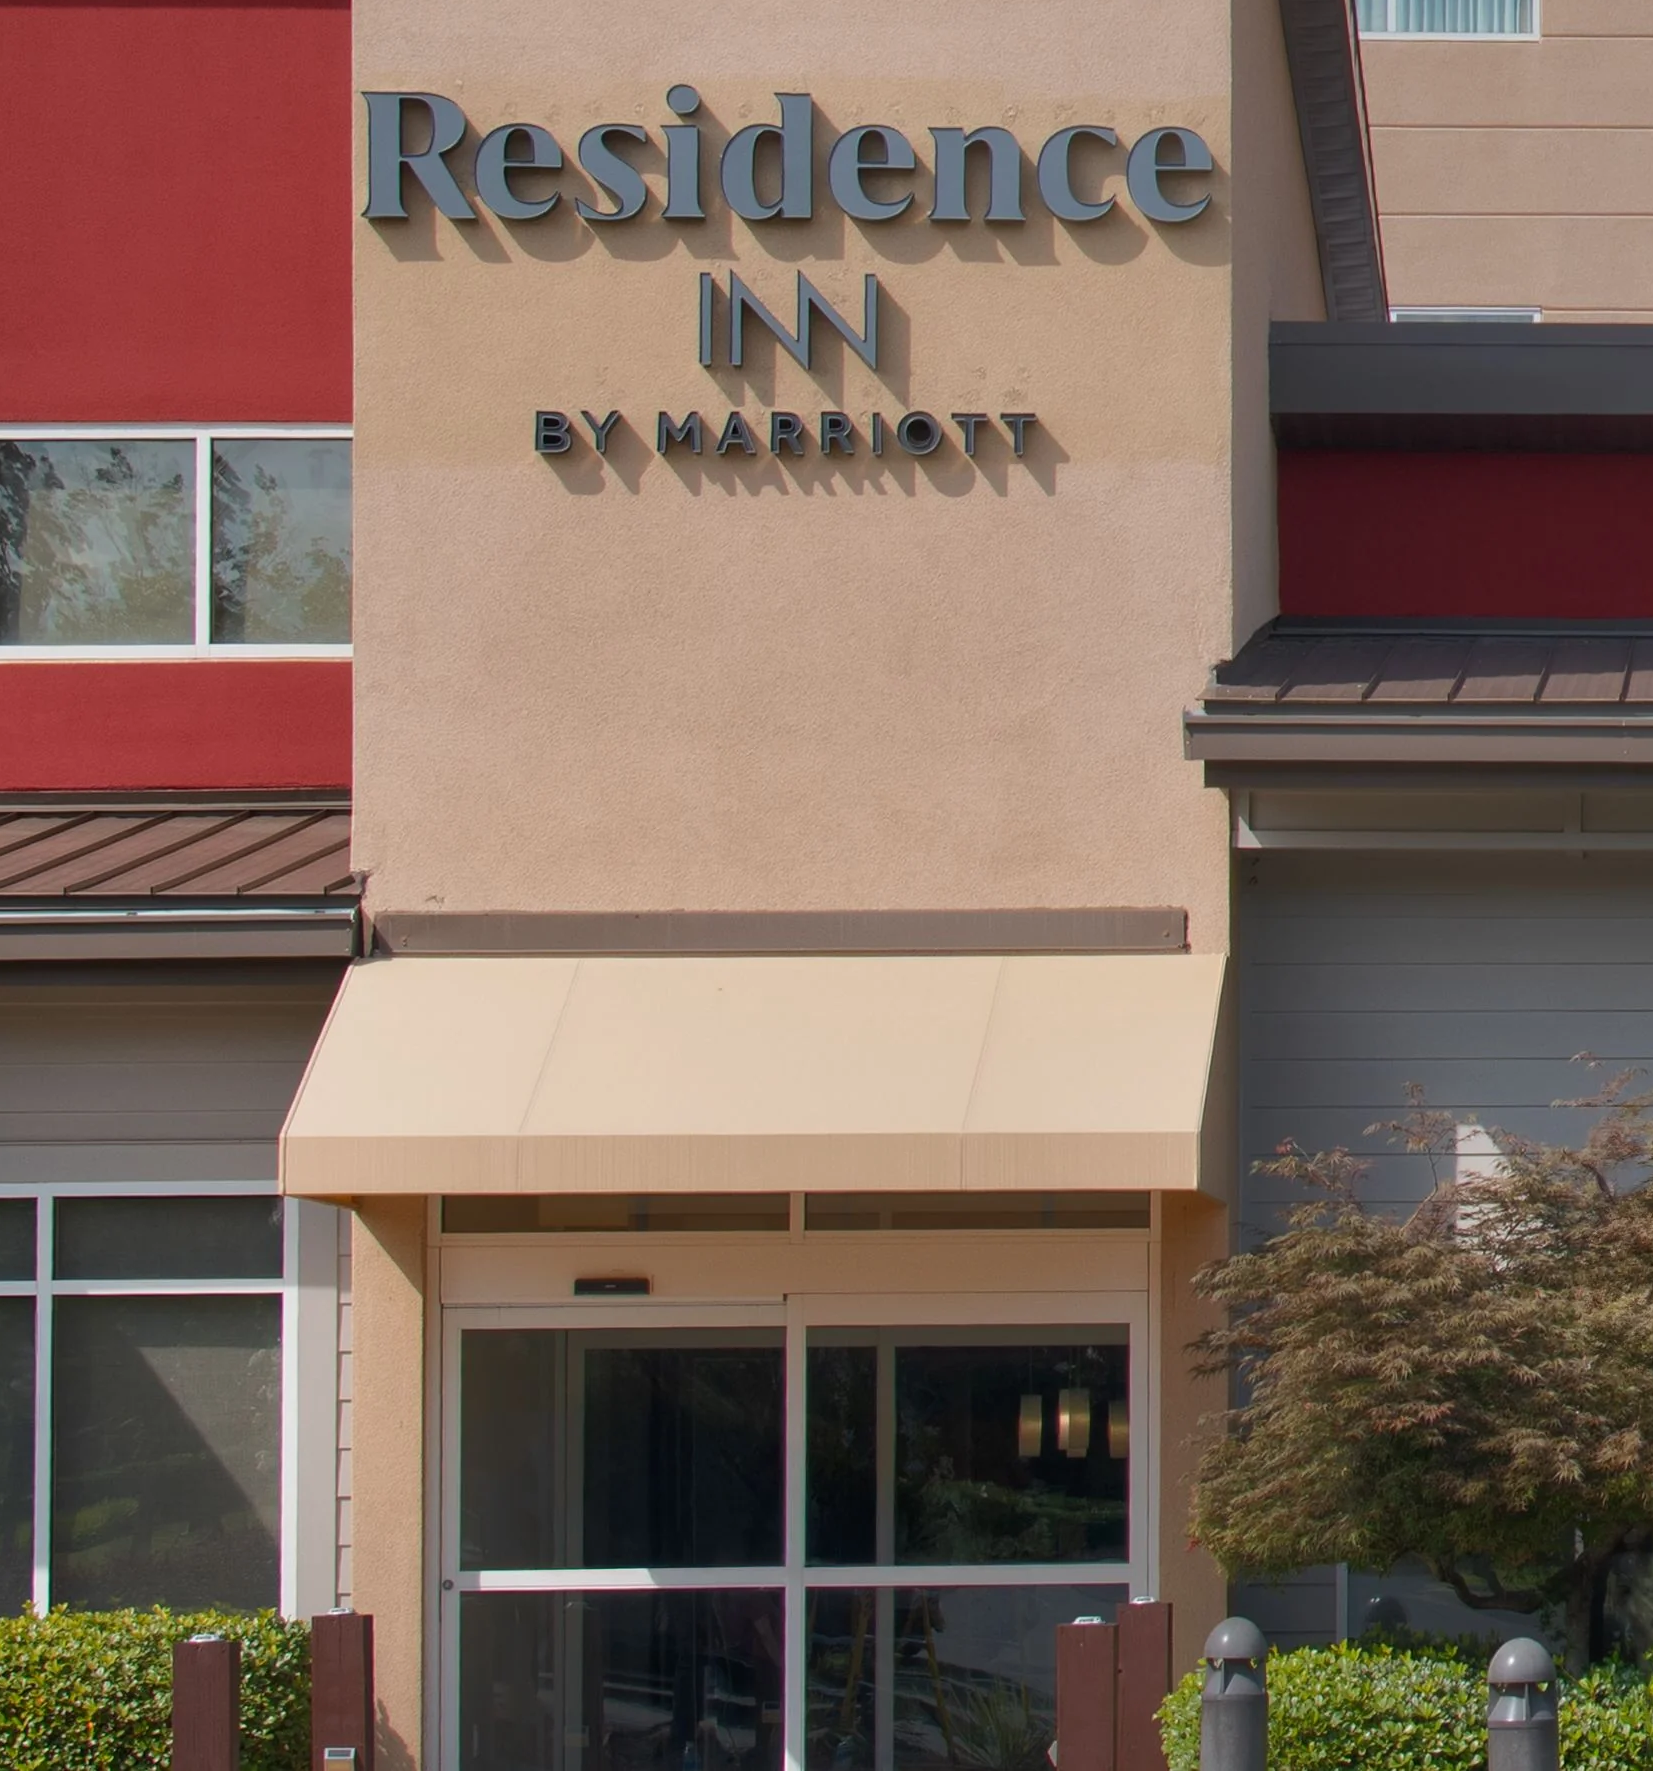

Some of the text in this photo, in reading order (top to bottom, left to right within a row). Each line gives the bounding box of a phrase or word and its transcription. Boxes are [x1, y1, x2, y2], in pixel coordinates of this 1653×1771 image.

[361, 83, 1214, 224] Residence
[698, 269, 879, 371] INN
[533, 409, 1038, 458] BY MARRIOTT
